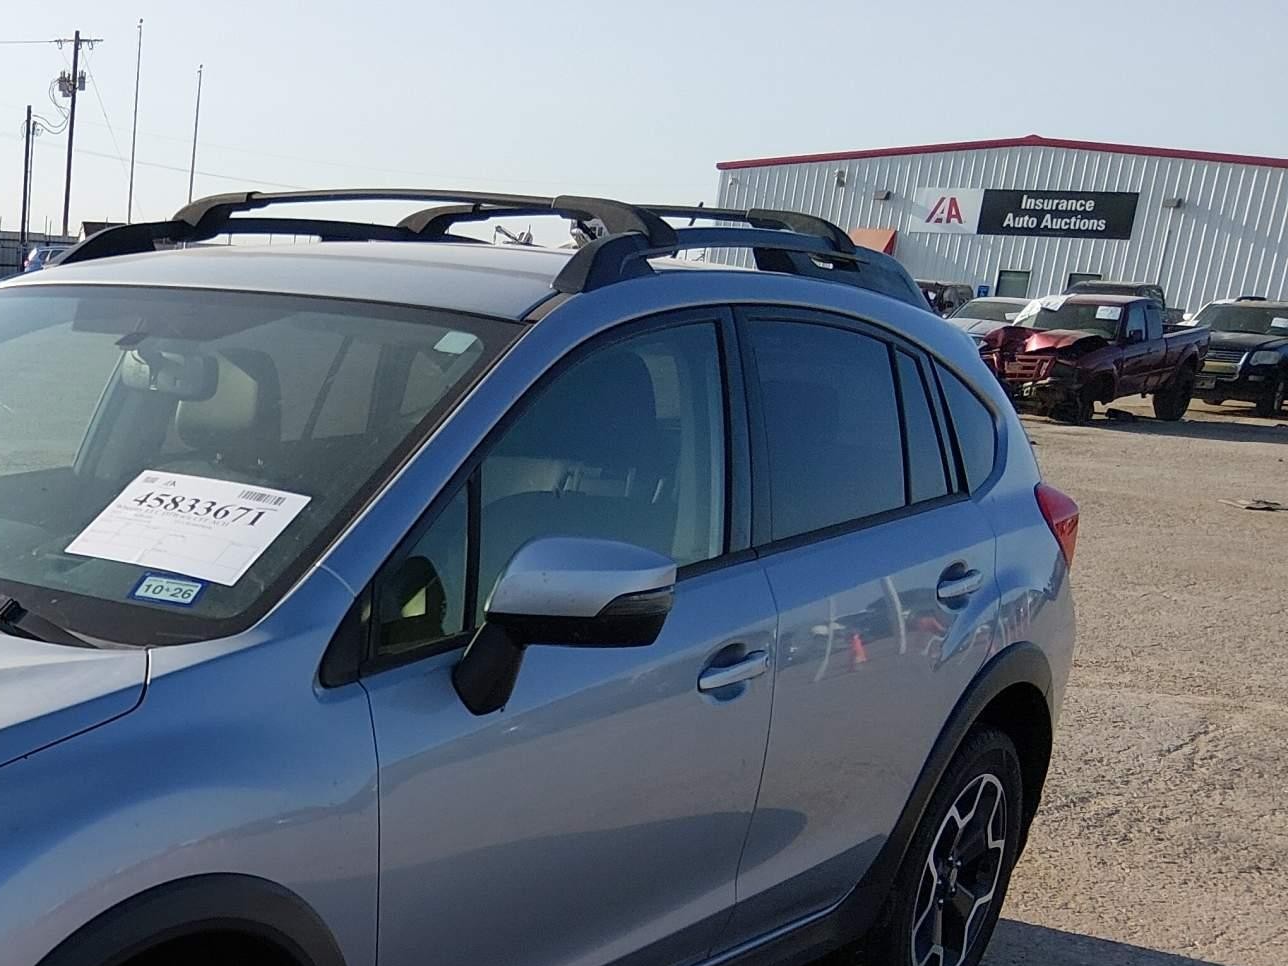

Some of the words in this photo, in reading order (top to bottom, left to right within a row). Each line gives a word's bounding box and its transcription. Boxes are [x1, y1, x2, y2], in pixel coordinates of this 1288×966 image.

[1021, 194, 1095, 211] Insurance
[1003, 213, 1037, 228] Auto
[1040, 214, 1106, 231] Auctions
[133, 492, 268, 527] 45833671
[170, 587, 194, 599] 26
